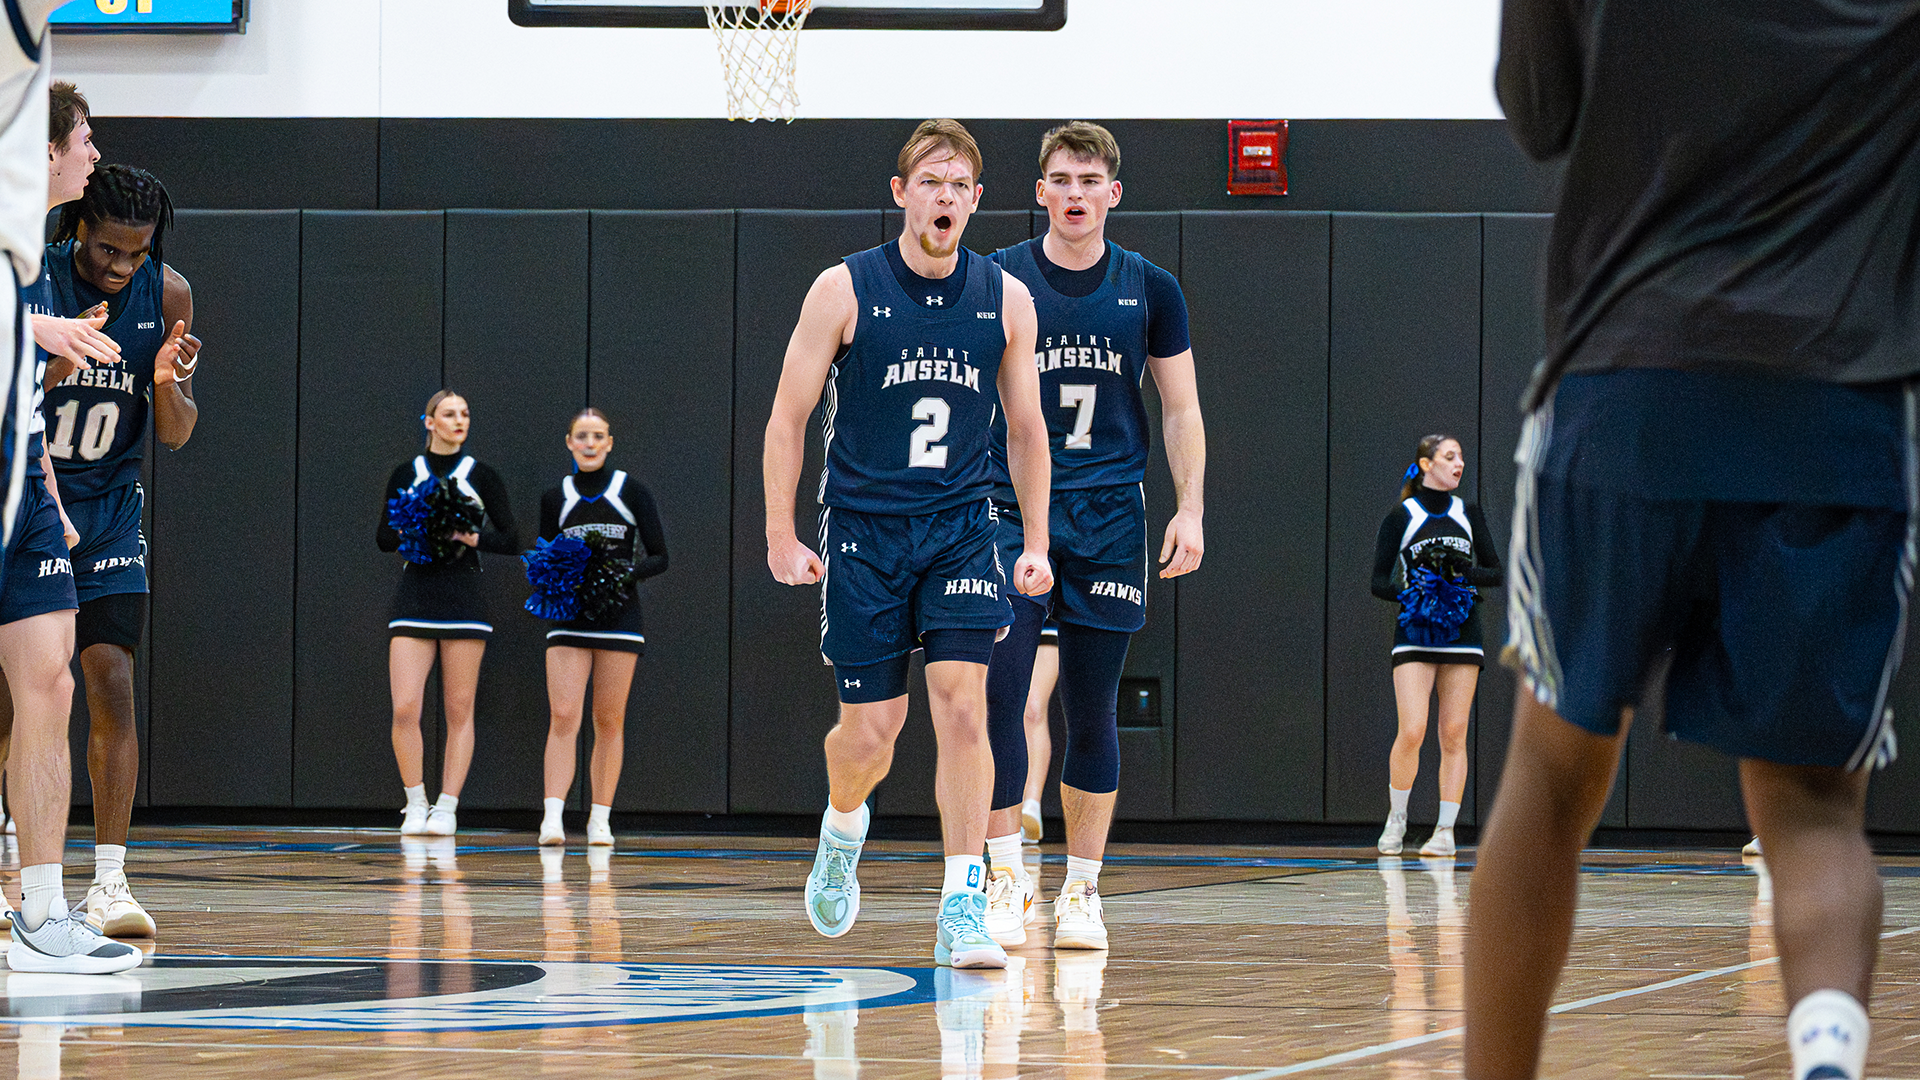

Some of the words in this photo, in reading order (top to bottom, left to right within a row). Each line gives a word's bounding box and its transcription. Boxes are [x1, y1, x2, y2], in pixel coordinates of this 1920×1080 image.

[901, 347, 970, 363] SAINT
[1045, 334, 1112, 349] SAINT
[1035, 346, 1123, 376] ANSELM
[56, 367, 136, 395] NSELM
[881, 359, 981, 394] ANSELM
[48, 400, 121, 462] 10
[1059, 383, 1097, 450] 7
[908, 396, 951, 469] 2
[1089, 581, 1143, 607] HAWKS
